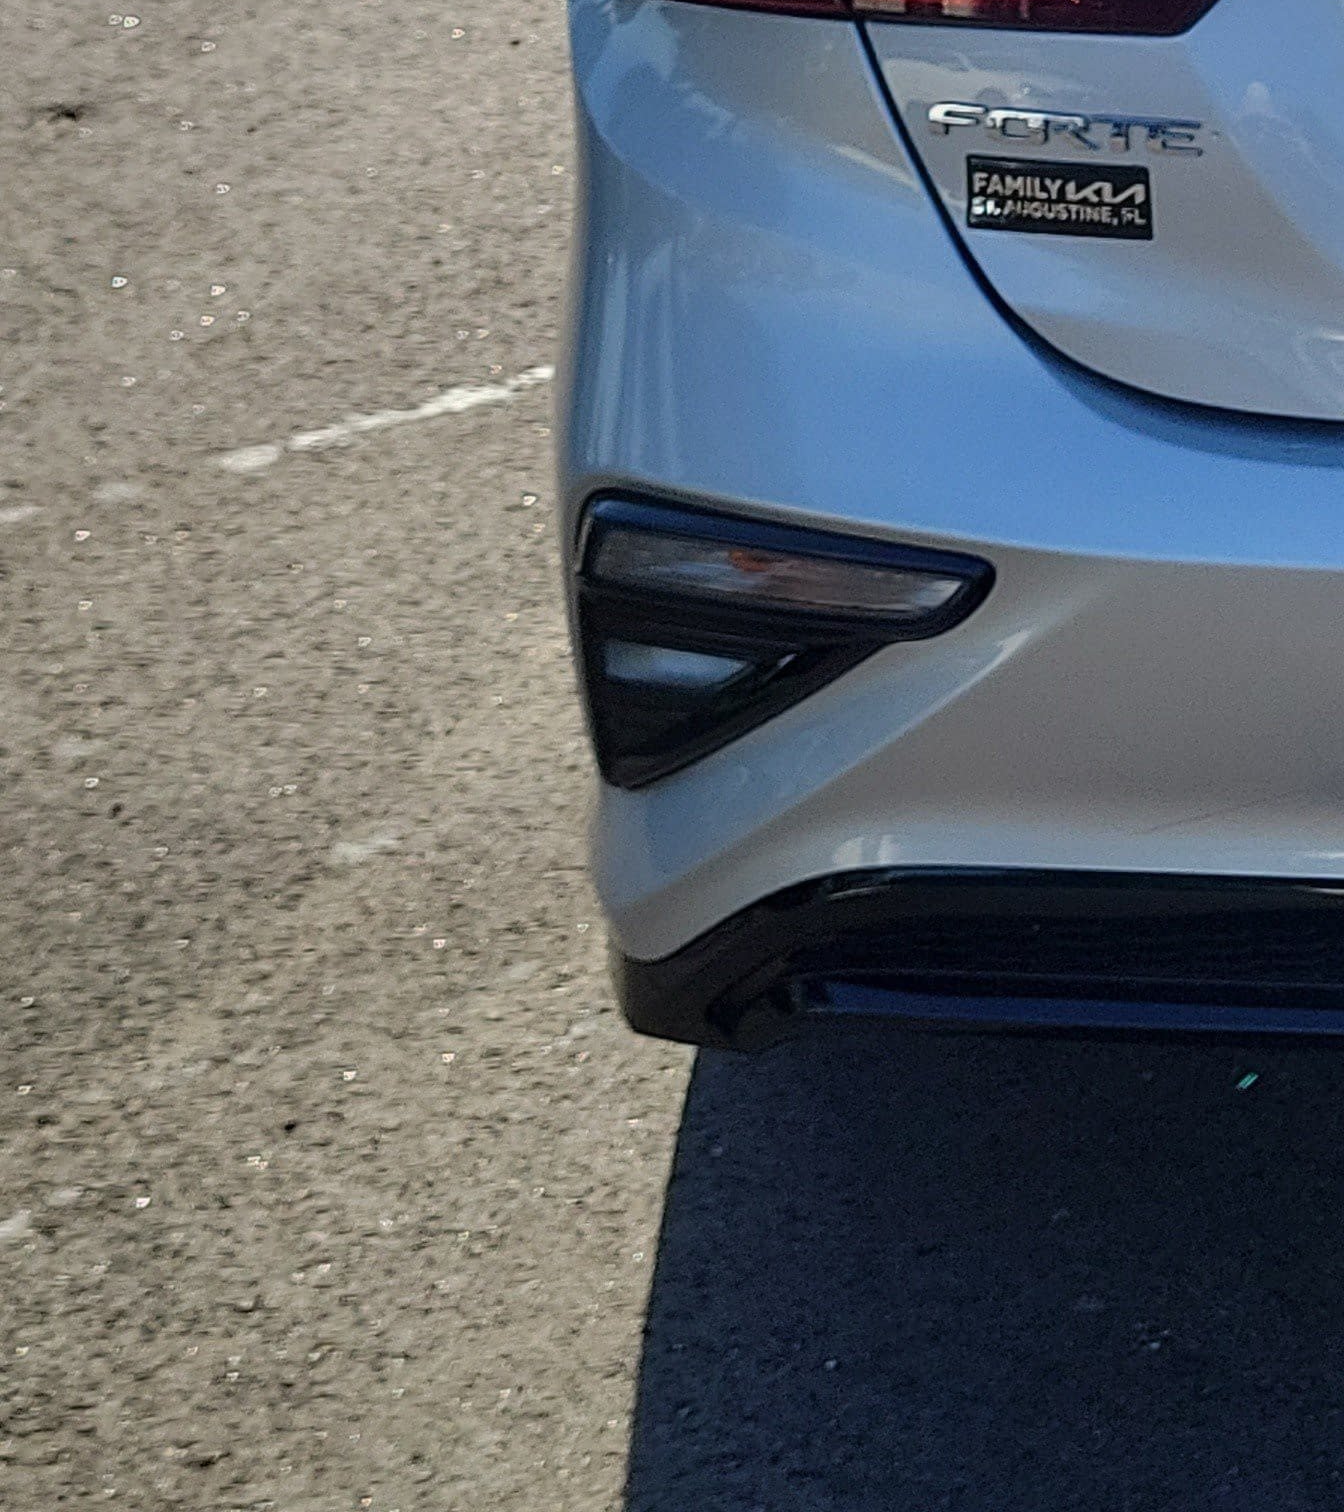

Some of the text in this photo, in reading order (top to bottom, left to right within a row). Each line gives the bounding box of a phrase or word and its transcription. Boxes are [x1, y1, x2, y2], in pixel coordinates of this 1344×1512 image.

[927, 101, 1203, 157] FORTE
[971, 171, 1062, 201] FAMILY
[1002, 200, 1118, 227] AUGUSTINE,
[1121, 208, 1147, 226] FL
